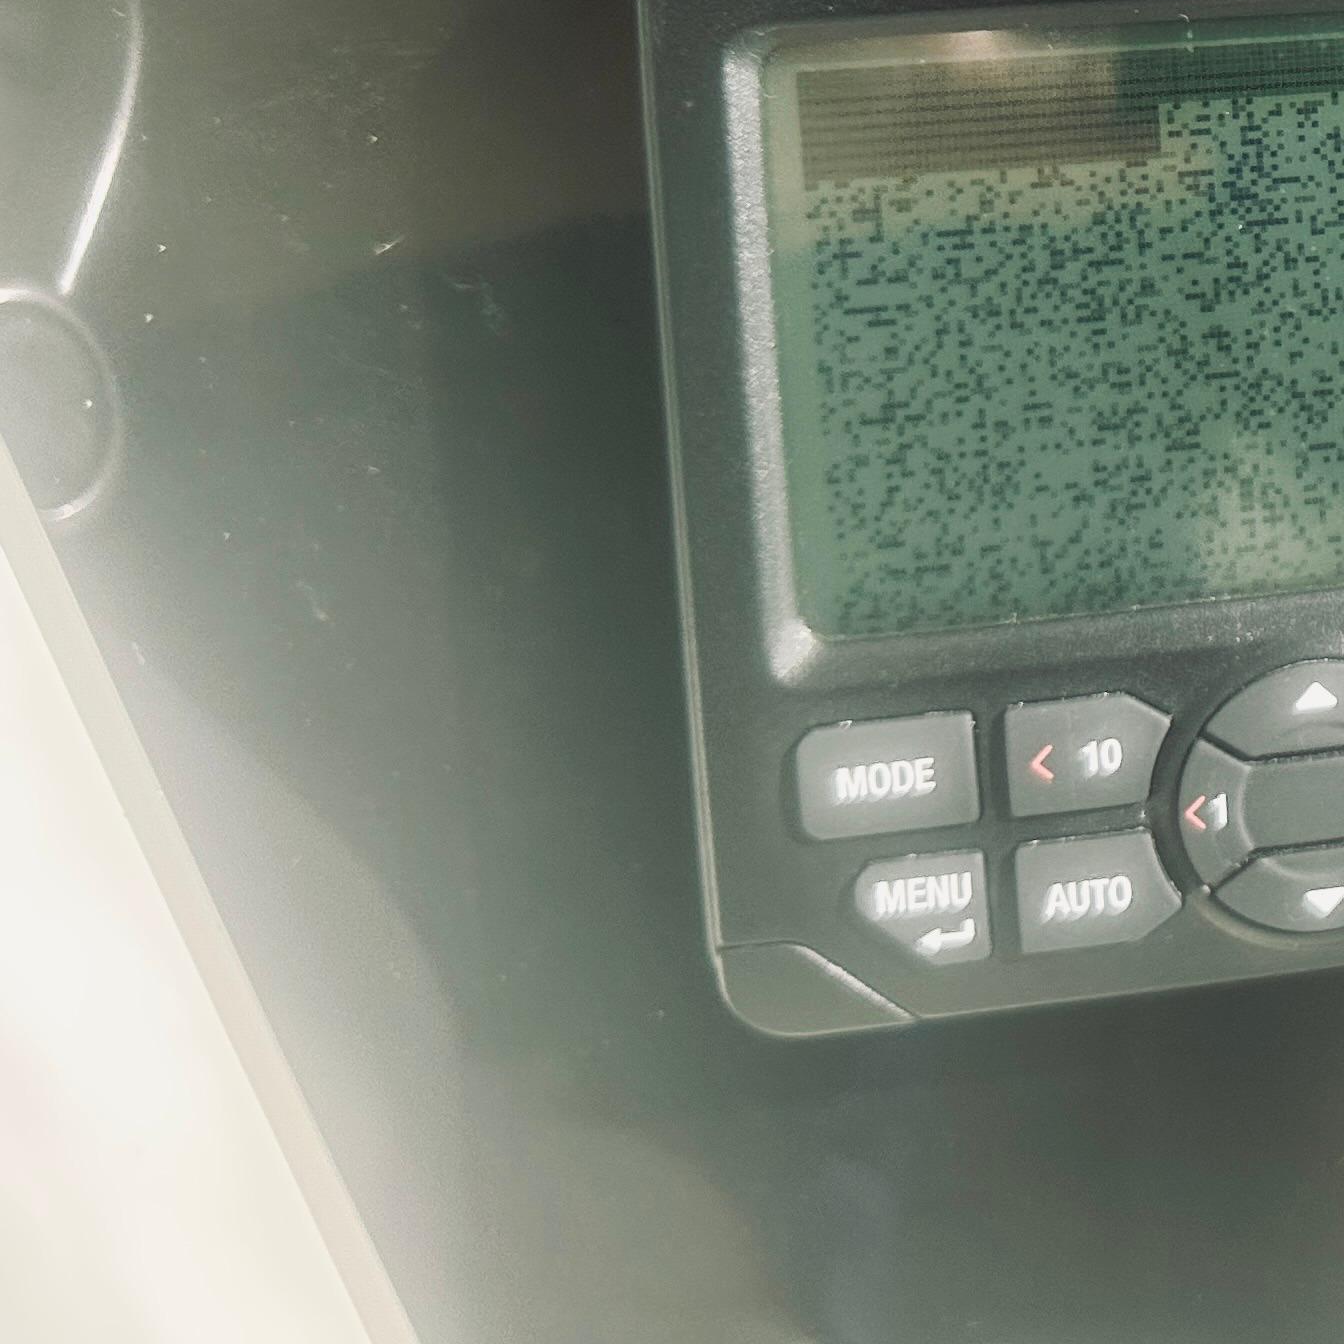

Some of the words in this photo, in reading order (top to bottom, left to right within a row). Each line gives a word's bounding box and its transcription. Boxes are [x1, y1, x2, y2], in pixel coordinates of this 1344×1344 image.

[835, 757, 937, 801] MODE
[1079, 737, 1123, 777] 10
[873, 871, 973, 918] MENU
[1044, 874, 1133, 919] AUTO
